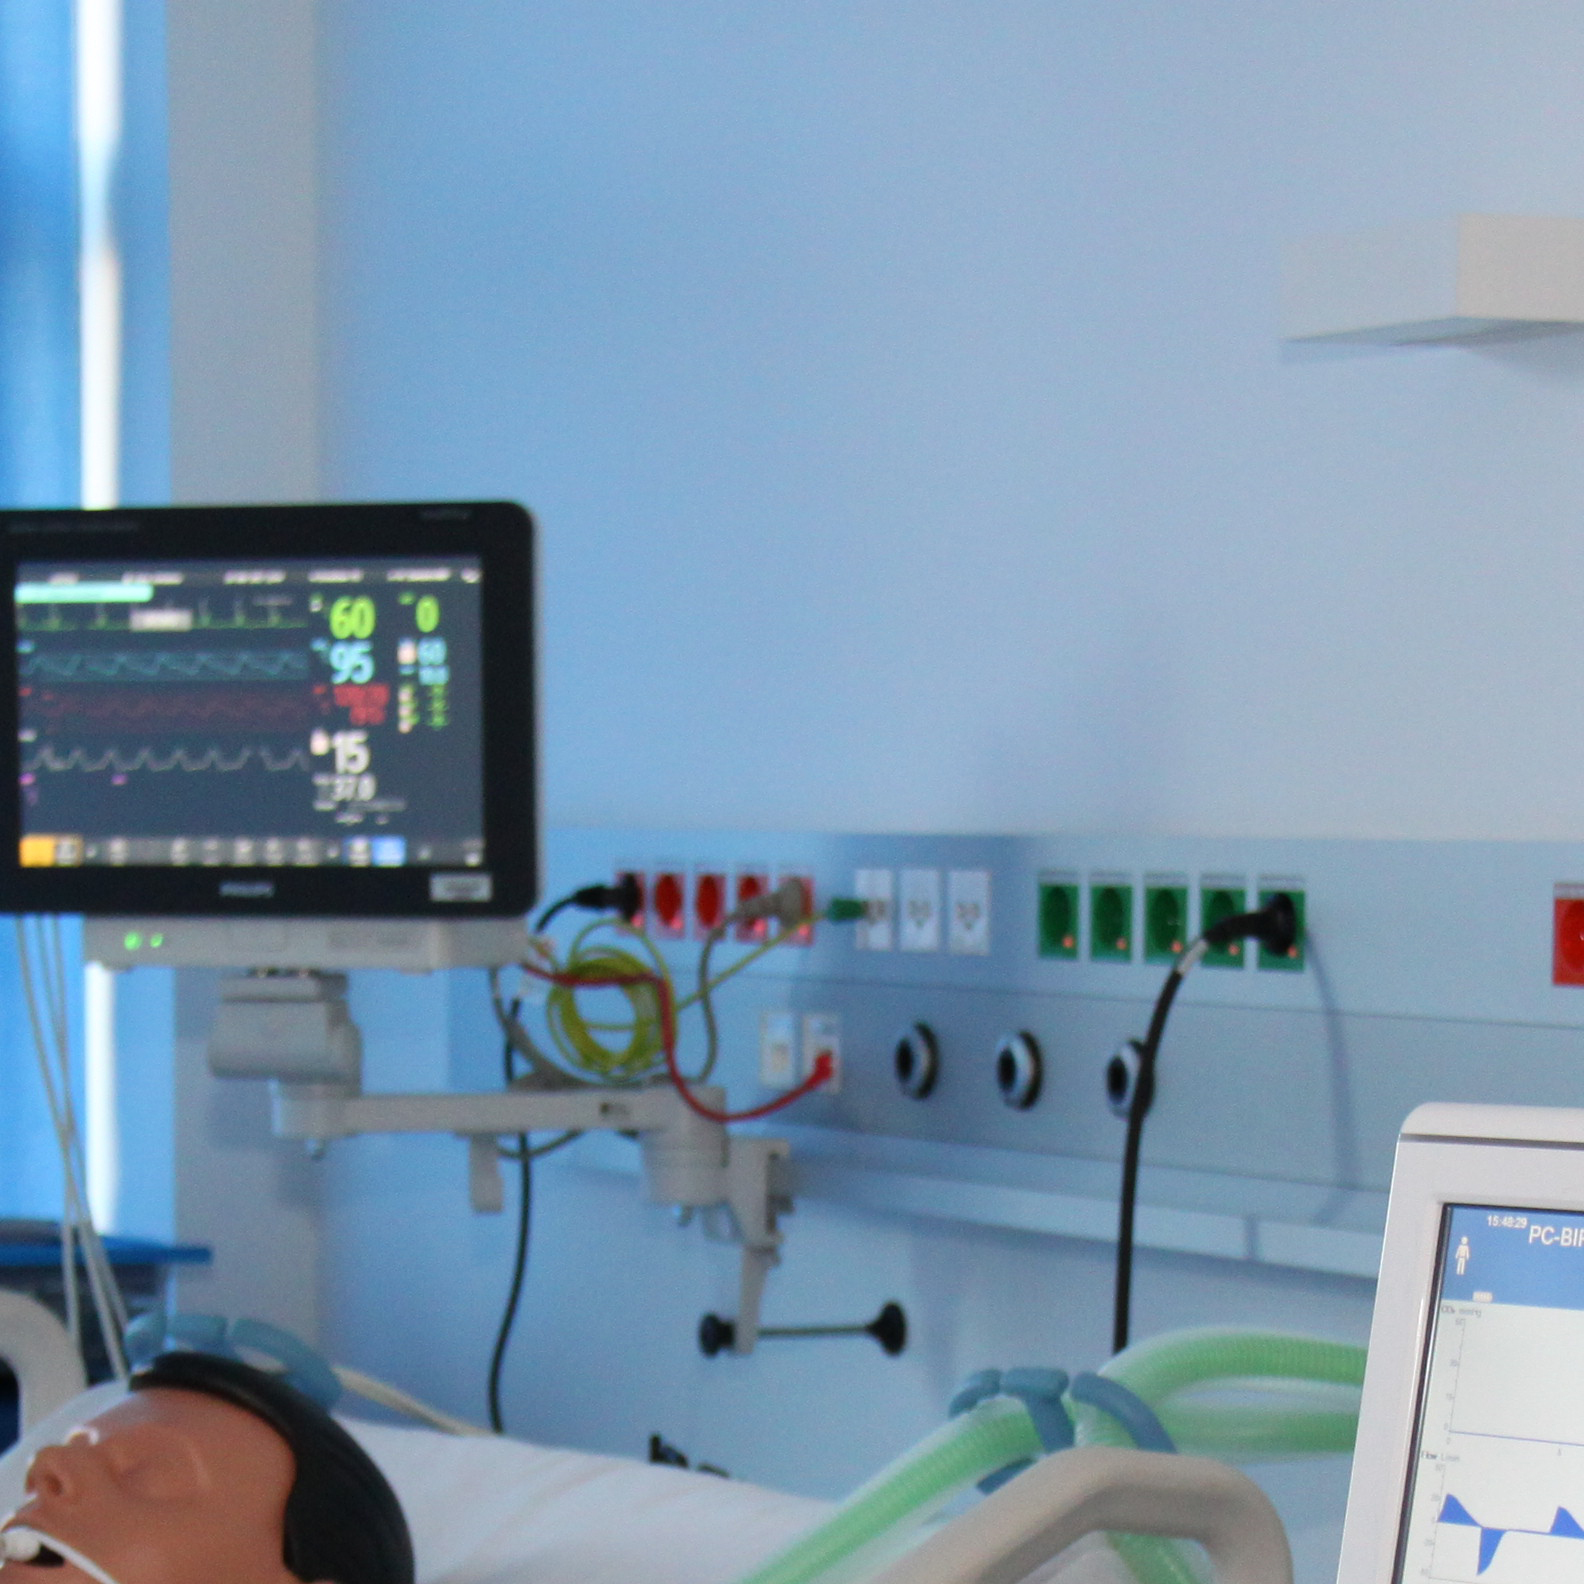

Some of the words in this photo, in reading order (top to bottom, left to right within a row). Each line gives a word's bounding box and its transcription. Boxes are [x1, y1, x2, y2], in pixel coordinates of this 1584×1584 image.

[330, 595, 376, 640] 60
[416, 594, 440, 633] 0
[330, 639, 375, 684] 95
[332, 729, 370, 775] 15
